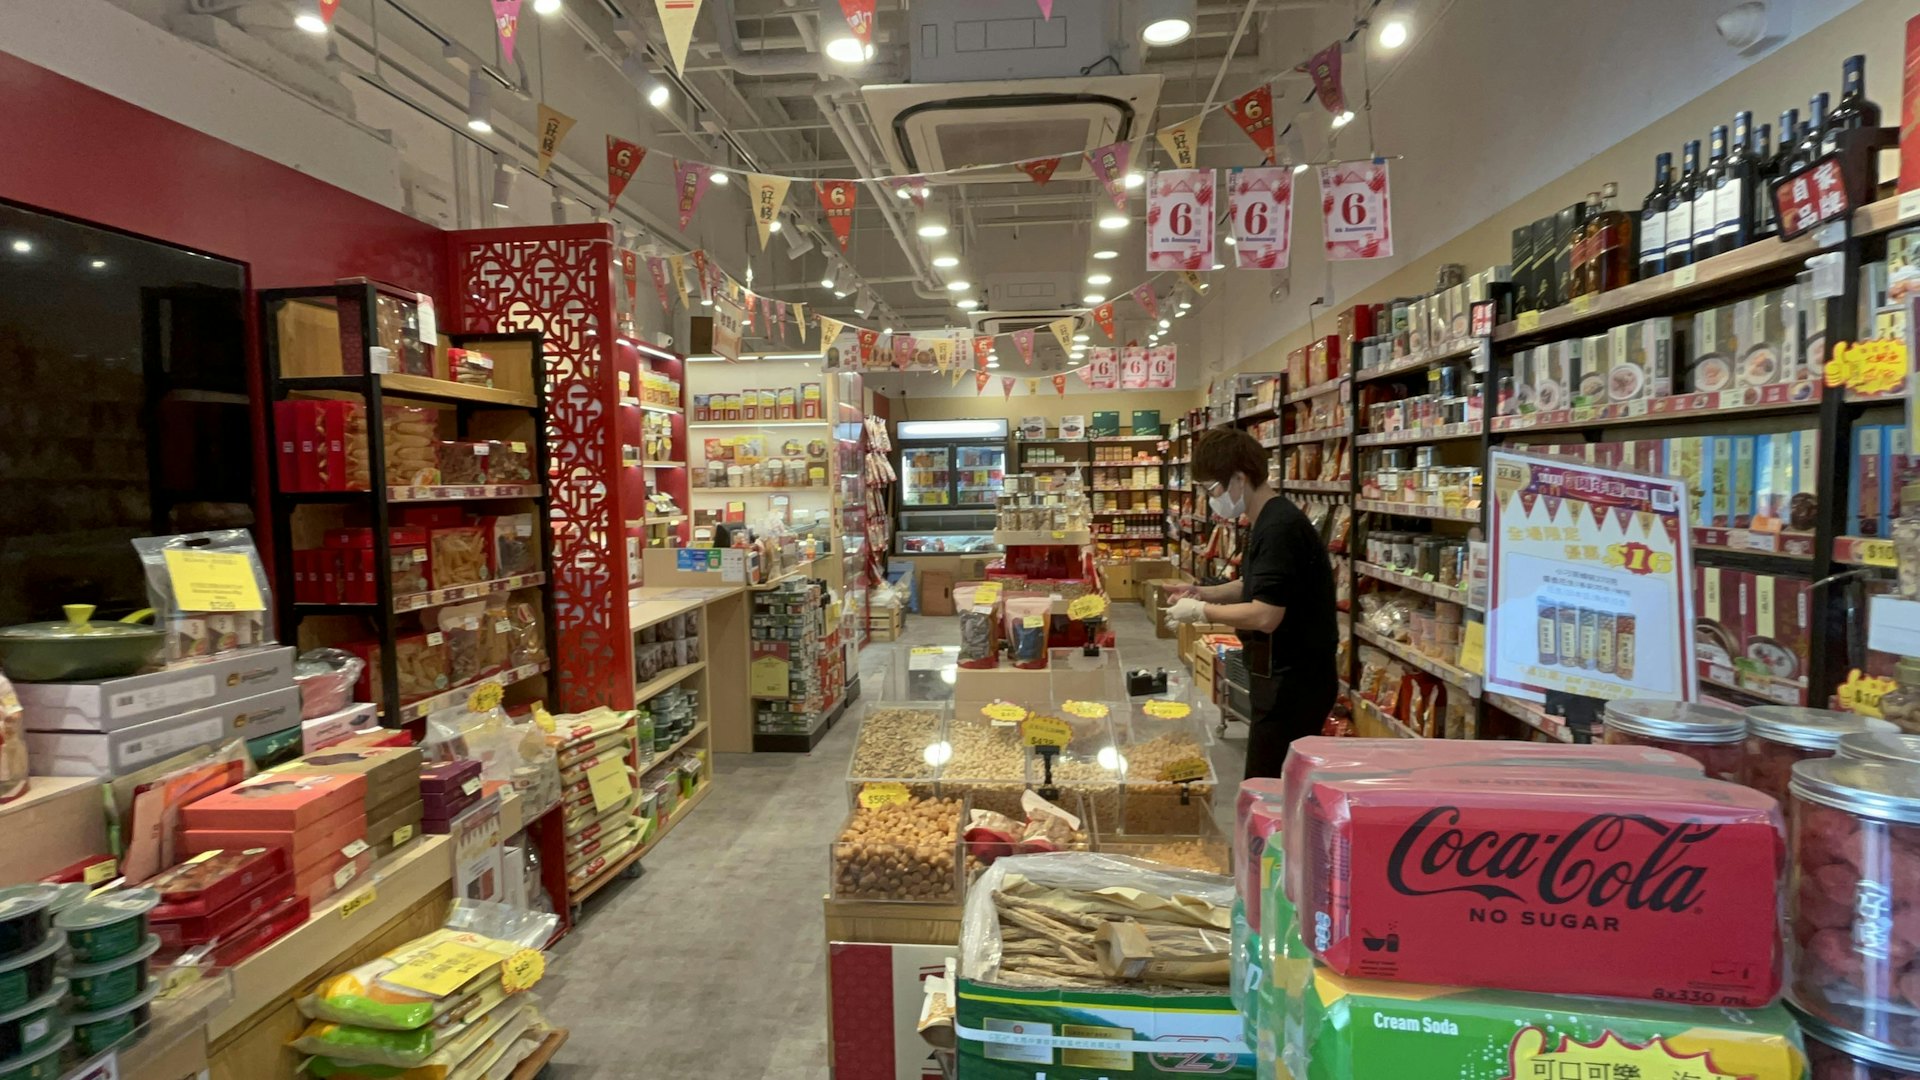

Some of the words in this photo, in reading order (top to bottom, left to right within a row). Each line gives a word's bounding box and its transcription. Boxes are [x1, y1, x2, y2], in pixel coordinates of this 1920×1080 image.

[1244, 99, 1263, 120] 6
[617, 148, 632, 168] 6
[831, 186, 847, 206] 6
[1168, 202, 1192, 236] 6
[1244, 201, 1268, 235] 6
[1341, 193, 1366, 226] 6
[1098, 361, 1109, 375] 6
[1130, 360, 1140, 373] 6
[1156, 360, 1166, 373] 6
[1387, 806, 1722, 912] Coca-Cola
[1469, 908, 1508, 923] NO
[1521, 912, 1620, 931] SUGAR
[1373, 1012, 1420, 1031] Cream
[1422, 1016, 1459, 1036] Soda
[1530, 1059, 1641, 1080] 可口可樂
